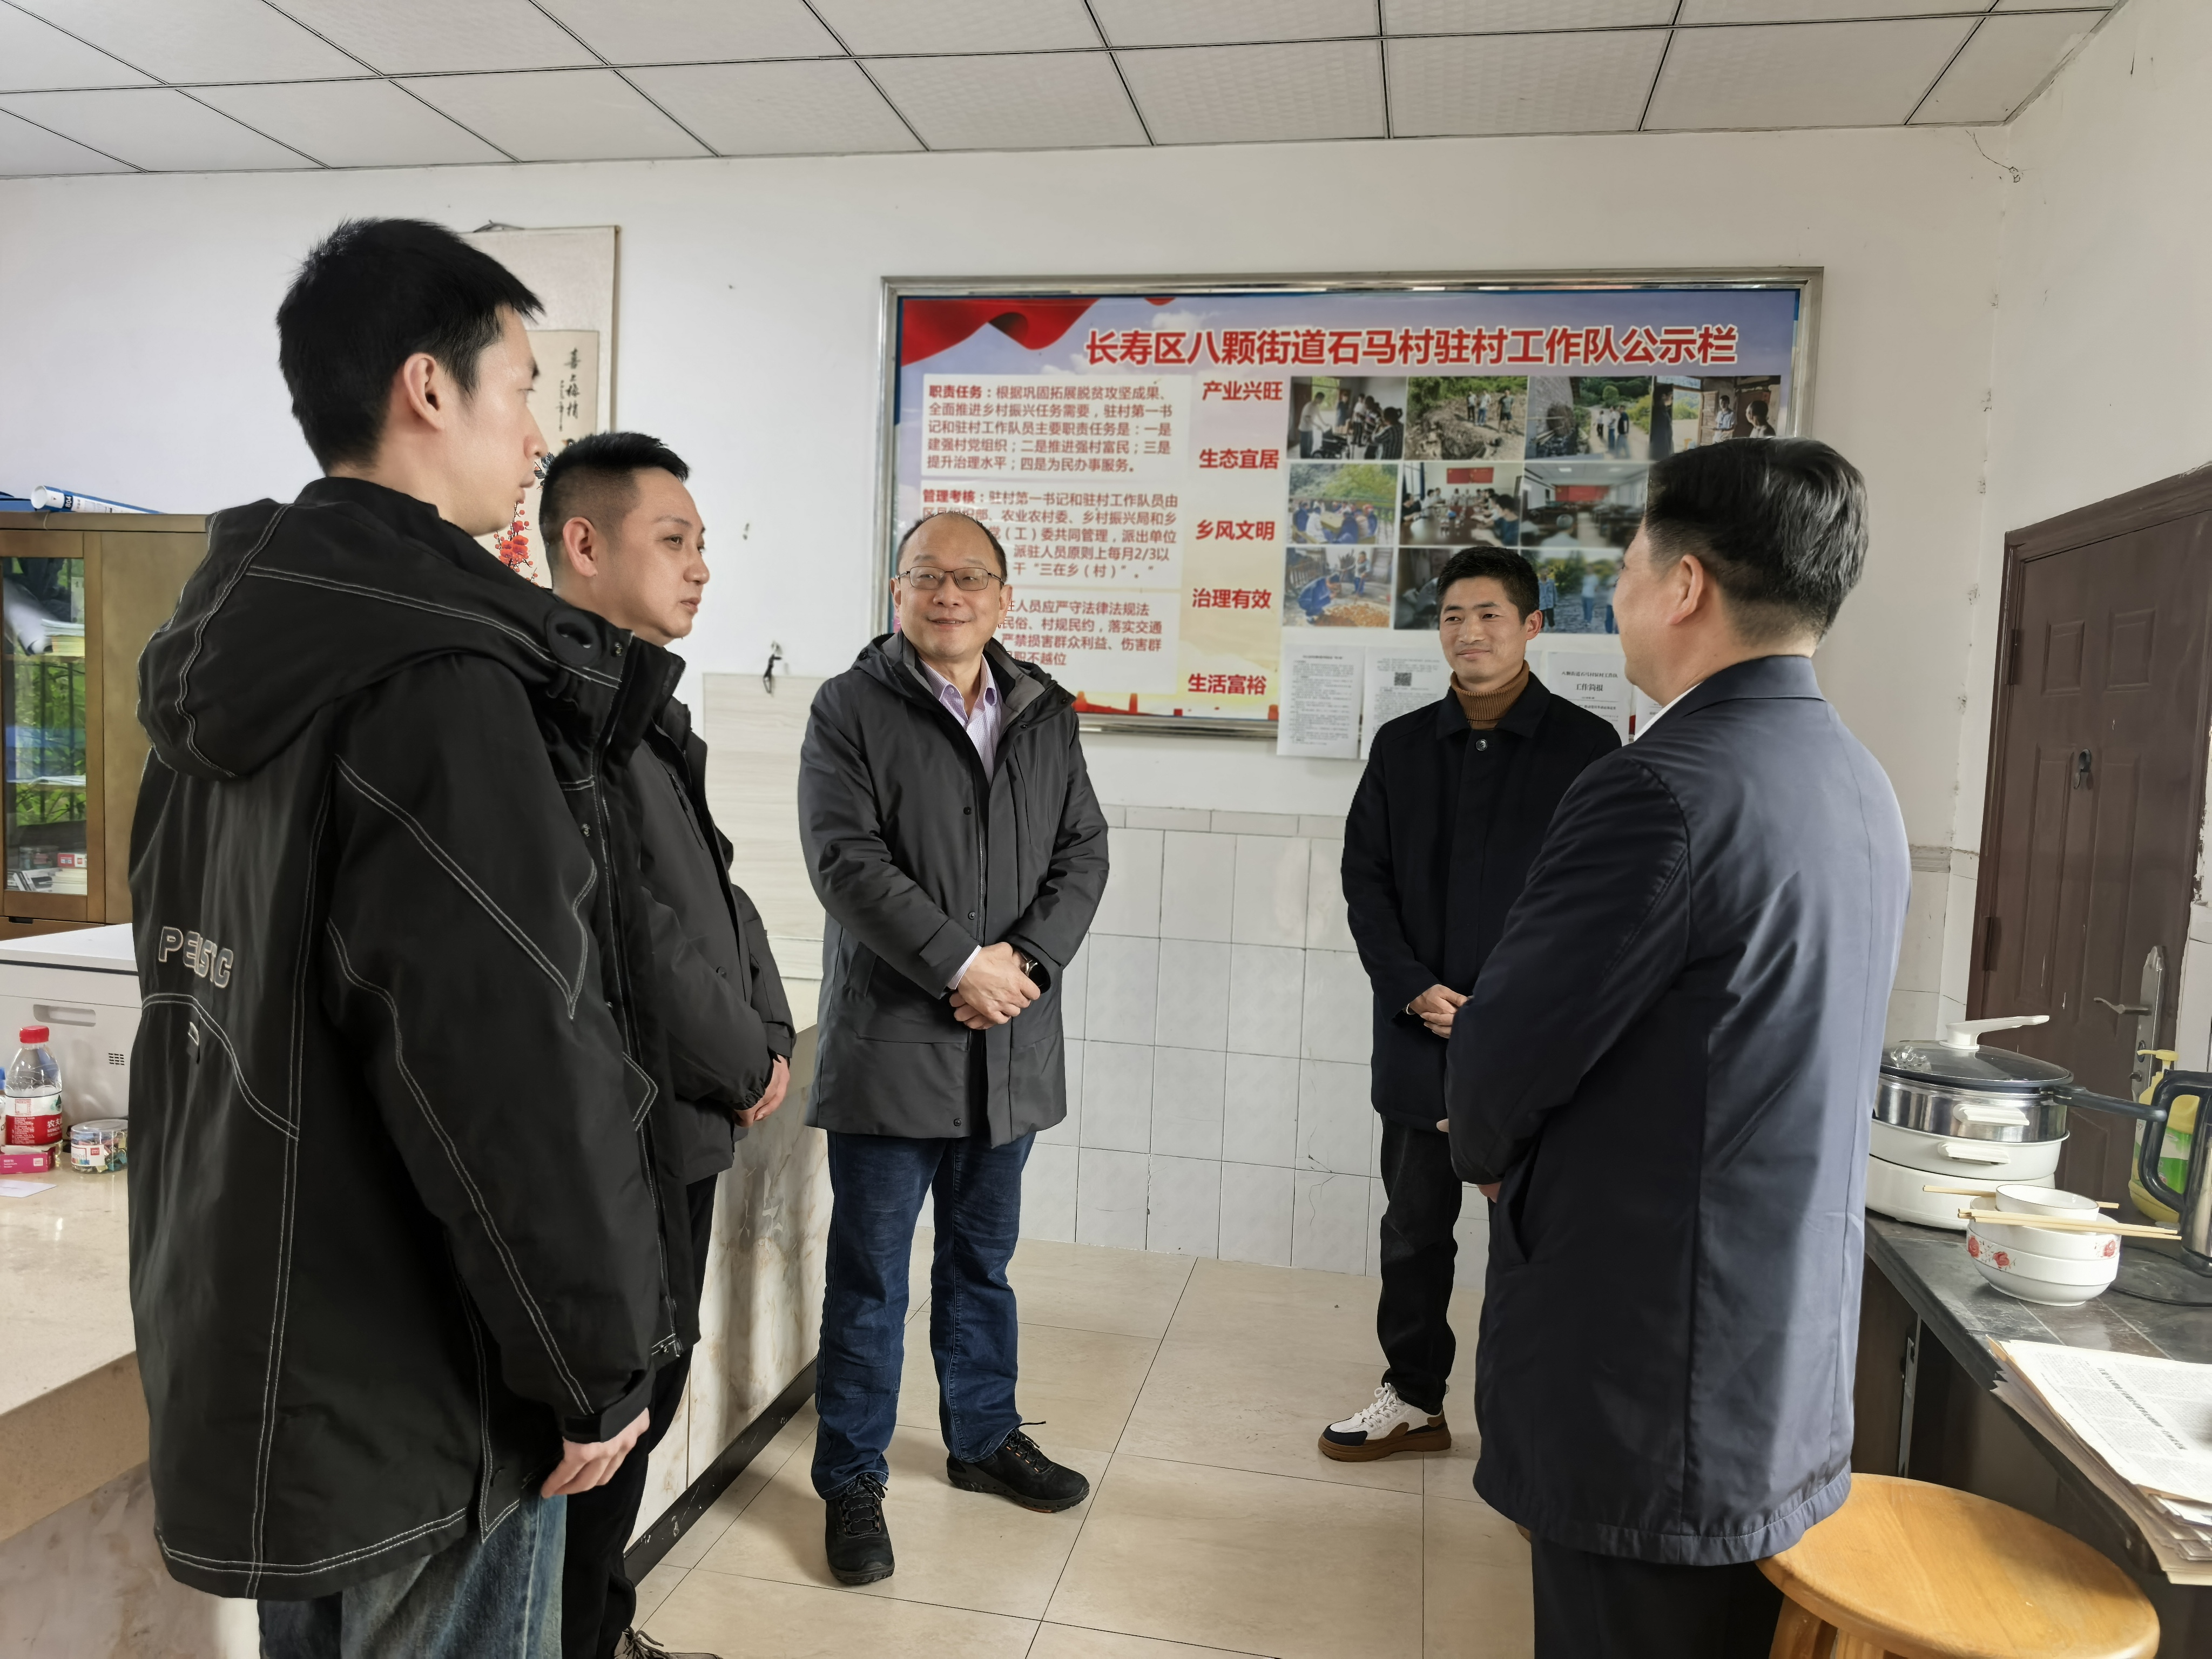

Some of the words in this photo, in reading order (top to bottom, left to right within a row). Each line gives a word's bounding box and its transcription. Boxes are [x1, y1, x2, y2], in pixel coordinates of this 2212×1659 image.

[1085, 326, 1738, 366] 长寿区八颗街道石马村驻村工作队公示栏
[1202, 381, 1283, 401] 产业兴旺
[1198, 449, 1279, 470] 生态宜居
[1196, 519, 1275, 541] 乡风文明
[1192, 588, 1272, 610] 治理有效
[999, 616, 1162, 635] 民俗、村规民约，落实交通
[1188, 673, 1267, 696] 生活富裕
